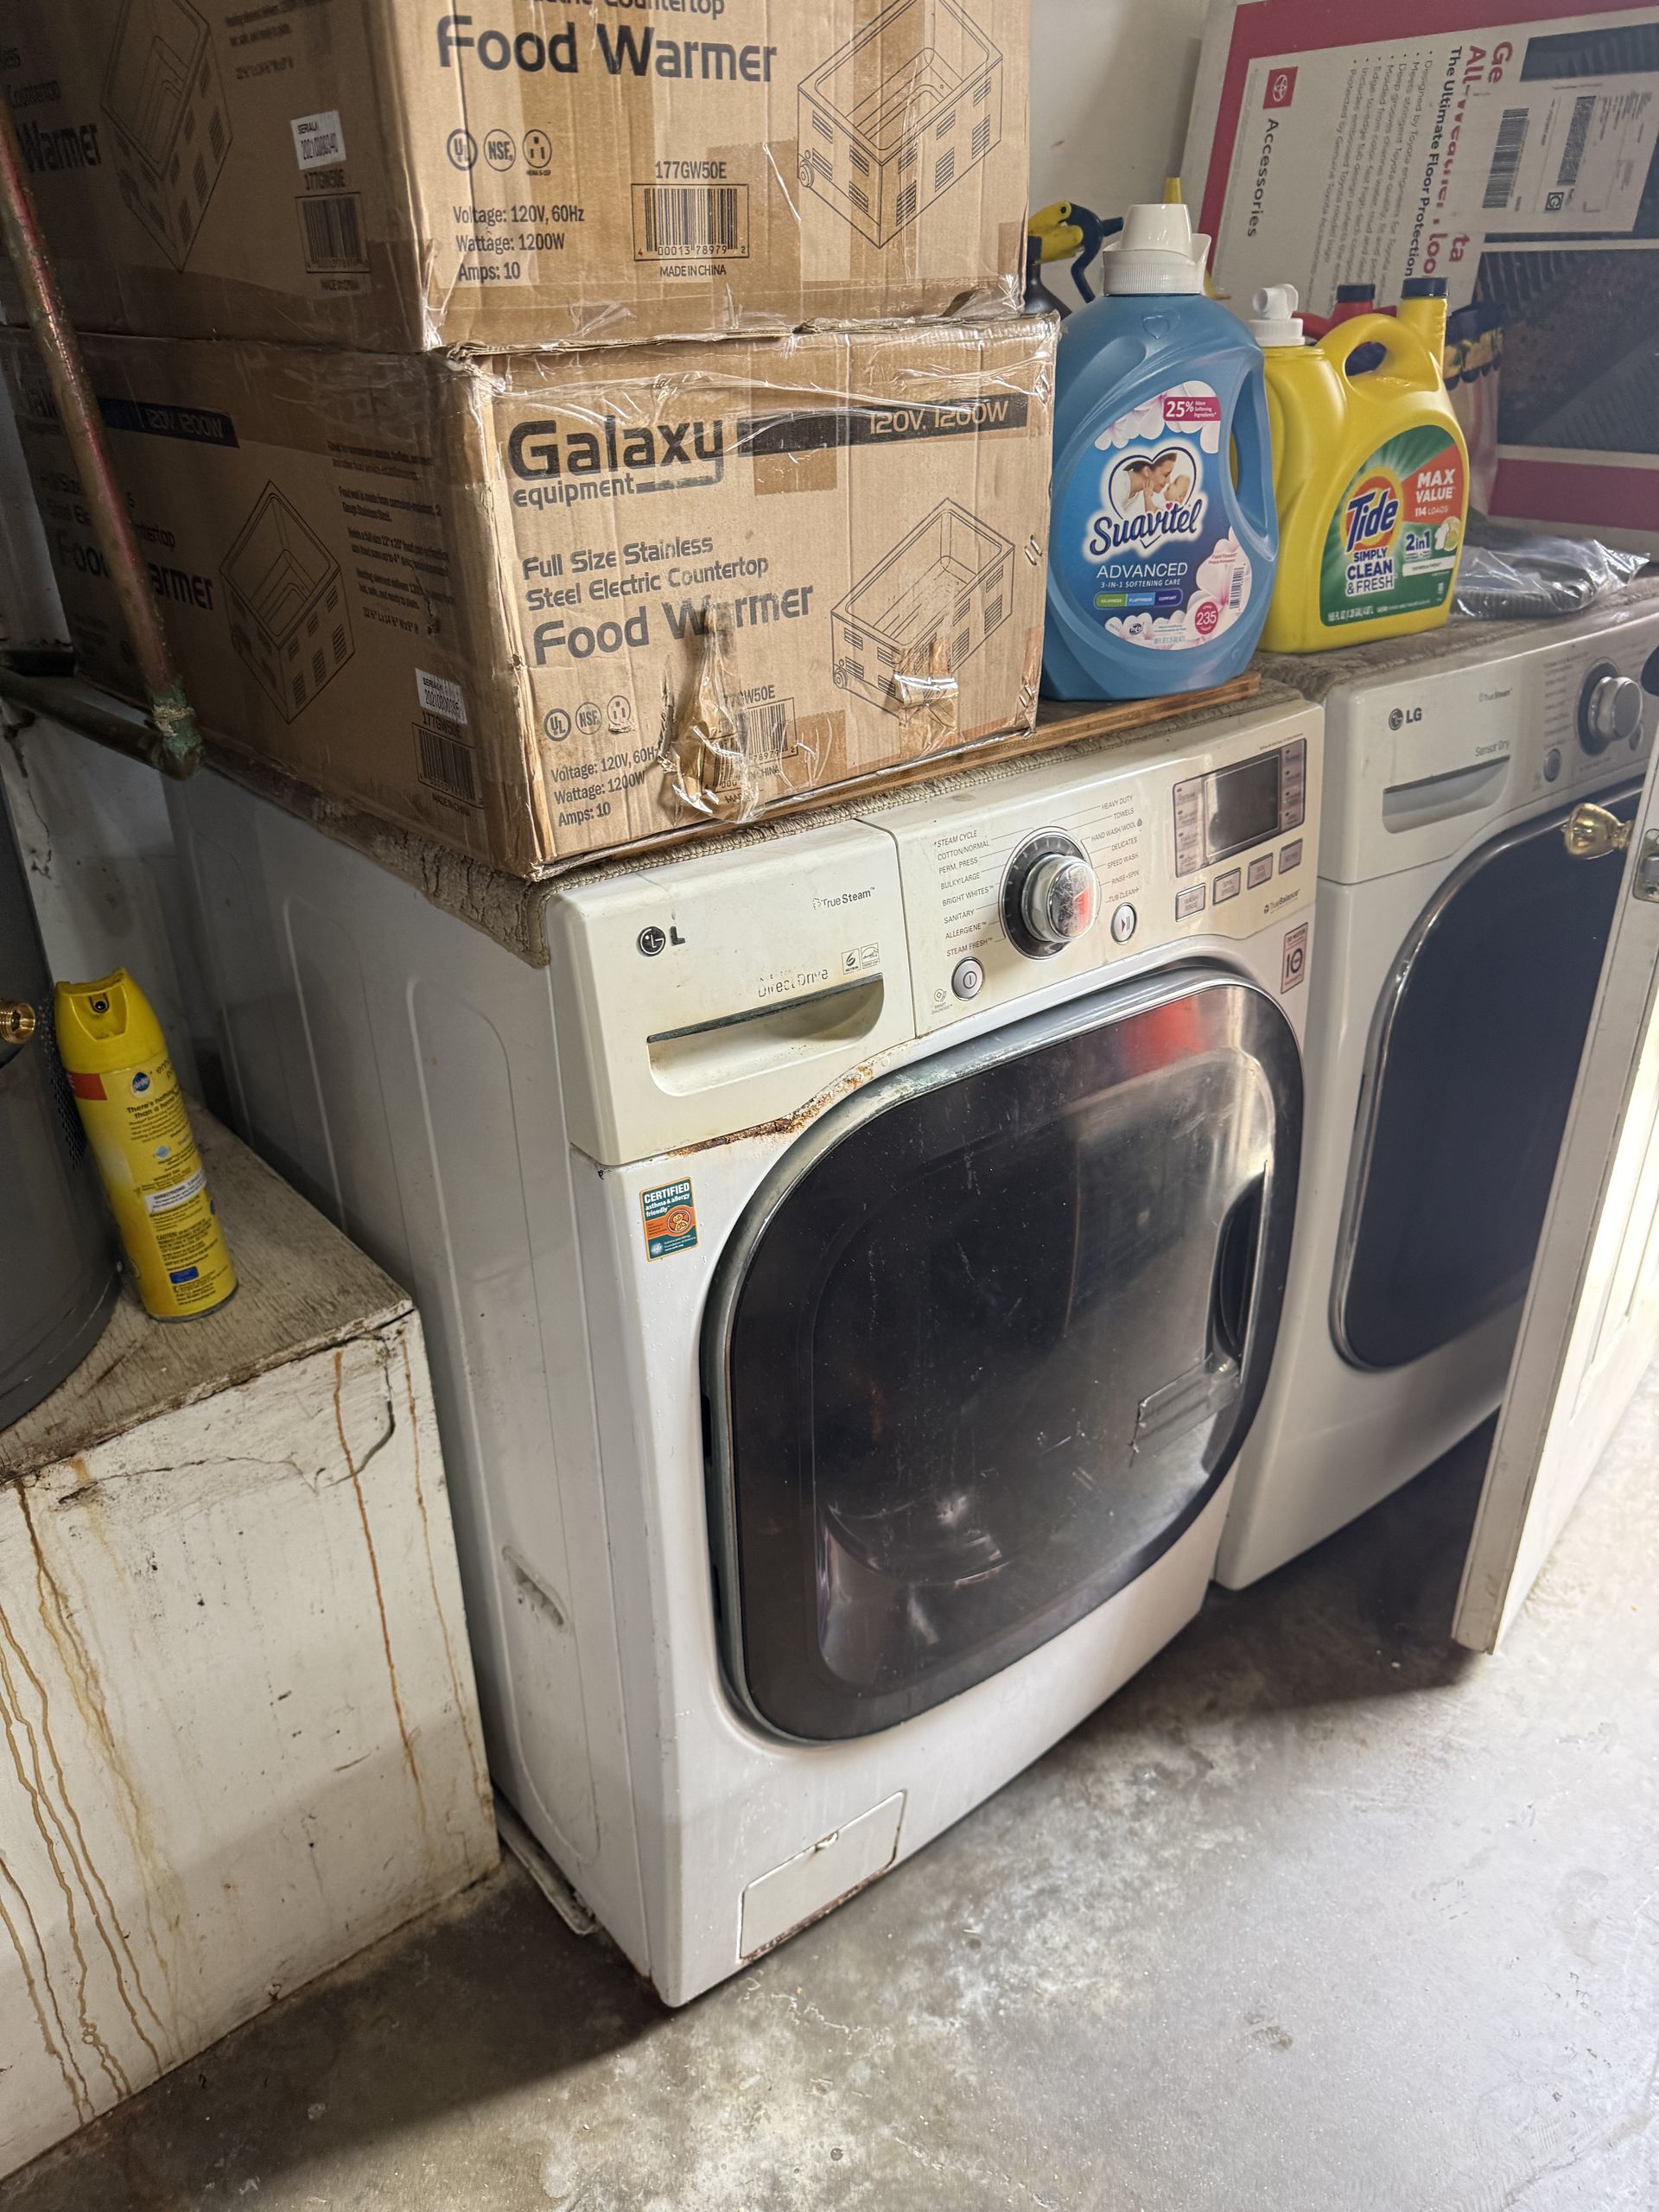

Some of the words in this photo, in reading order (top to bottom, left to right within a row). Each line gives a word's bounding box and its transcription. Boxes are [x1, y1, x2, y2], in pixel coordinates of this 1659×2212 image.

[437, 15, 579, 73] Food
[597, 23, 778, 83] Warmer
[1445, 47, 1461, 75] The
[1429, 81, 1455, 149] Ultimate
[655, 161, 728, 179] 177GW50E
[1244, 121, 1280, 236] Accessories
[1420, 155, 1438, 192] Floor
[454, 205, 506, 227] Voltage:
[511, 205, 549, 226] 120V,
[551, 204, 585, 223] 60Hz
[455, 234, 515, 255] Wattage:
[518, 232, 565, 251] 1200W
[1403, 200, 1429, 275] Protection
[658, 245, 690, 256] 00013
[696, 245, 727, 255] 78979
[458, 263, 500, 284] Amps:
[504, 261, 521, 280] 10
[660, 265, 687, 277] MADE
[688, 264, 697, 276] IN
[698, 264, 727, 276] CHINA
[868, 410, 926, 435] 120V,
[933, 400, 1009, 429] 1200W
[1166, 400, 1194, 417] 25%
[506, 415, 724, 480] Galaxy
[1416, 469, 1456, 489] MAX
[512, 472, 635, 512] equipment
[1415, 487, 1454, 504] VALUE
[1346, 487, 1400, 553] Tide
[1415, 507, 1427, 517] 114
[1089, 498, 1203, 556] Suavitel
[522, 554, 563, 581] Full
[570, 549, 617, 574] Size
[623, 537, 714, 565] Stainless
[1353, 547, 1388, 563] SIMPLY
[1096, 562, 1188, 579] ADVANCED
[1346, 560, 1393, 581] CLEAN
[147, 562, 214, 612] armer
[525, 583, 582, 612] Steel
[589, 571, 662, 601] Electric
[668, 556, 769, 588] Countertop
[1125, 579, 1163, 588] SOFTENING
[1164, 578, 1181, 587] CARE
[1346, 582, 1356, 594] &
[1356, 575, 1394, 593] FRESH
[533, 605, 651, 666] Food
[662, 585, 815, 640] Wrmer
[1196, 611, 1217, 626] 235
[550, 716, 566, 734] UL
[1406, 707, 1422, 724] LG
[1475, 742, 1497, 757] Sensor
[1497, 740, 1510, 755] Dry
[550, 763, 599, 783] Voltage:
[601, 753, 632, 773] 120V,
[632, 746, 660, 764] 60Hz
[554, 784, 606, 805] Wattage:
[607, 770, 646, 793] 1200W
[1101, 798, 1119, 810] HEAVY
[1119, 794, 1134, 806] DUTY
[558, 808, 595, 828] Amps:
[596, 801, 612, 818] 10
[1113, 807, 1135, 820] TOWELS
[958, 830, 977, 843] CYCLE
[1090, 831, 1107, 843] HAND
[1107, 821, 1136, 839] WASH/WOOL
[937, 840, 990, 861] COTTON/NORMAL
[1110, 836, 1138, 852] DELICATES
[938, 861, 958, 874] PERM.
[958, 856, 978, 869] PRESS
[1107, 857, 1123, 869] SPEED
[1123, 852, 1139, 864] WASH
[940, 872, 981, 890] BULKY/LARGE
[942, 893, 965, 906] BRIGHT
[944, 909, 975, 925] SANITARY
[946, 944, 969, 957] STEAM
[797, 969, 829, 988] Drive
[644, 1182, 690, 1205] CERTIFIED
[645, 1200, 666, 1211] asthma
[671, 1192, 690, 1203] allergy
